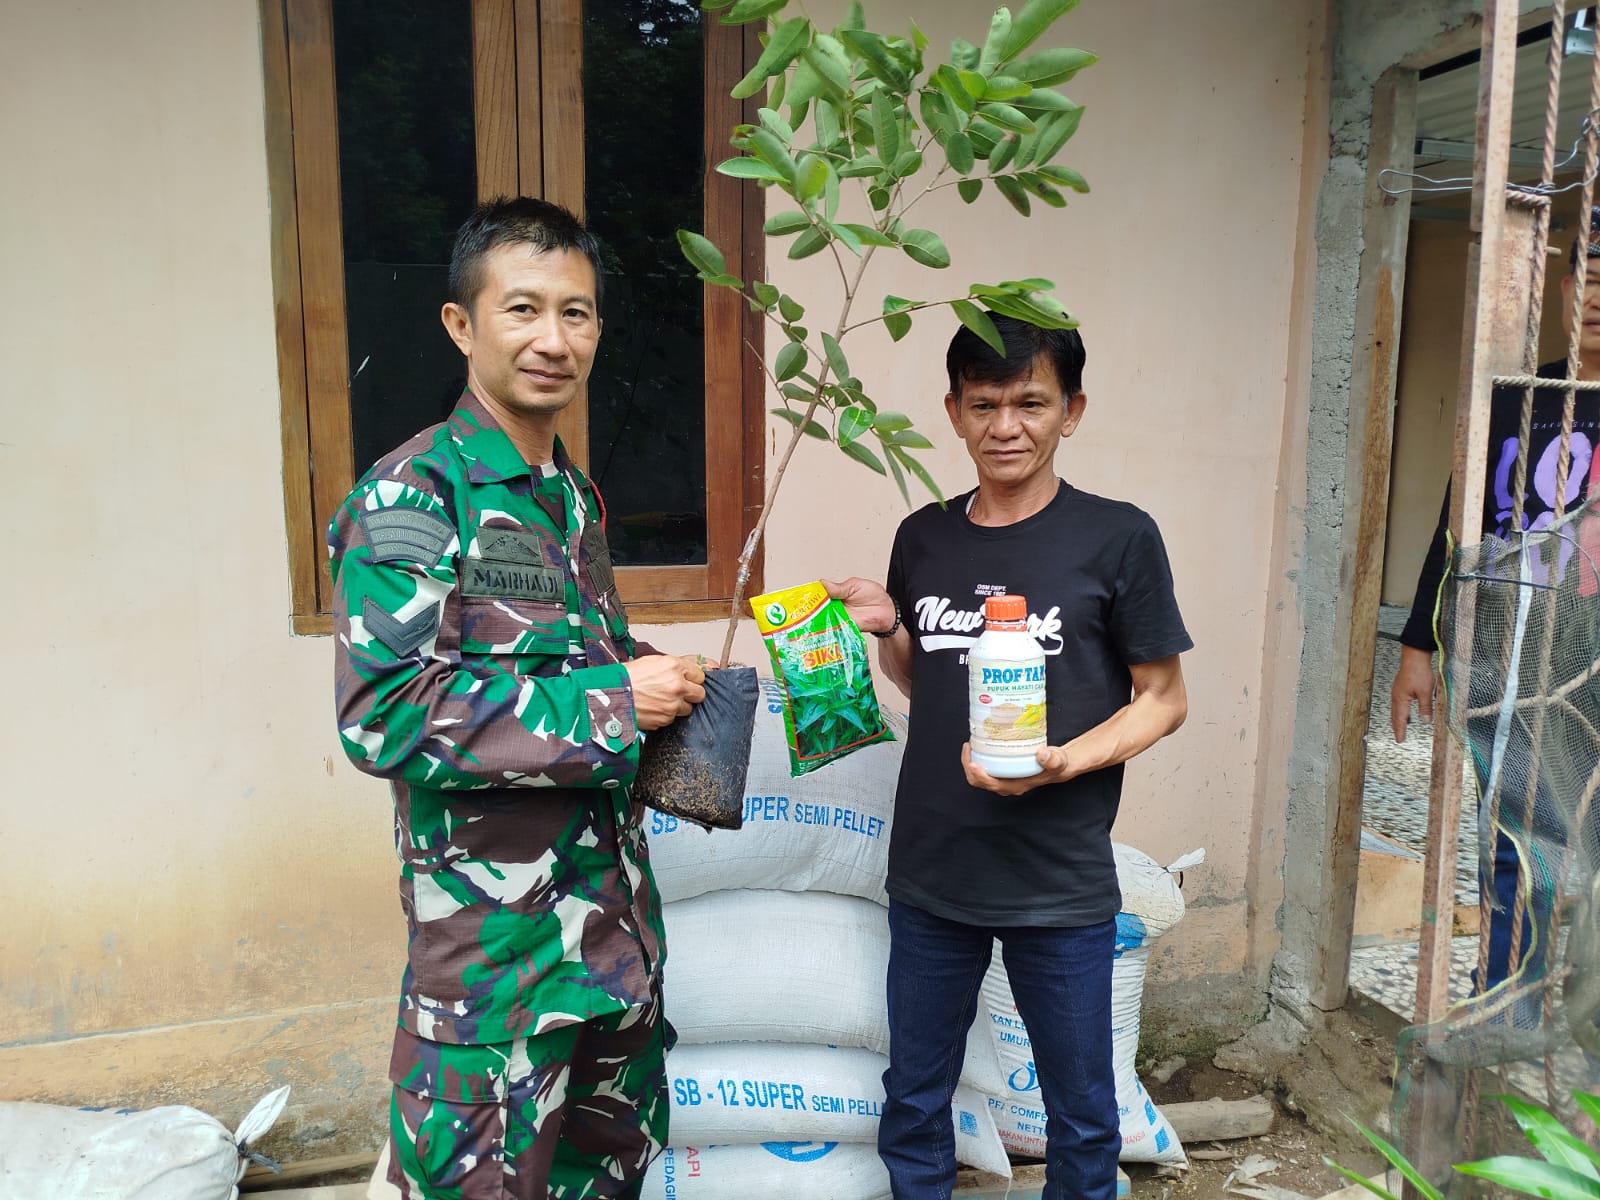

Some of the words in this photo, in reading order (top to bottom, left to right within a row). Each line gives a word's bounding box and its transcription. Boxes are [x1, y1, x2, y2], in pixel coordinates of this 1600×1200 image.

[473, 567, 562, 595] MARHADI
[974, 589, 992, 597] SINCE
[915, 596, 983, 632] New
[982, 667, 1022, 685] PROF
[987, 684, 1010, 692] PUPUK
[1011, 684, 1034, 692] HAYATI
[794, 803, 829, 826] SEMI
[833, 807, 886, 840] PELLET
[674, 1078, 702, 1107] SB
[717, 1079, 740, 1107] 12
[742, 1080, 807, 1111] SUPER
[811, 1095, 845, 1115] SEMI
[848, 1099, 884, 1118] PELL
[1017, 1121, 1047, 1136] NETT
